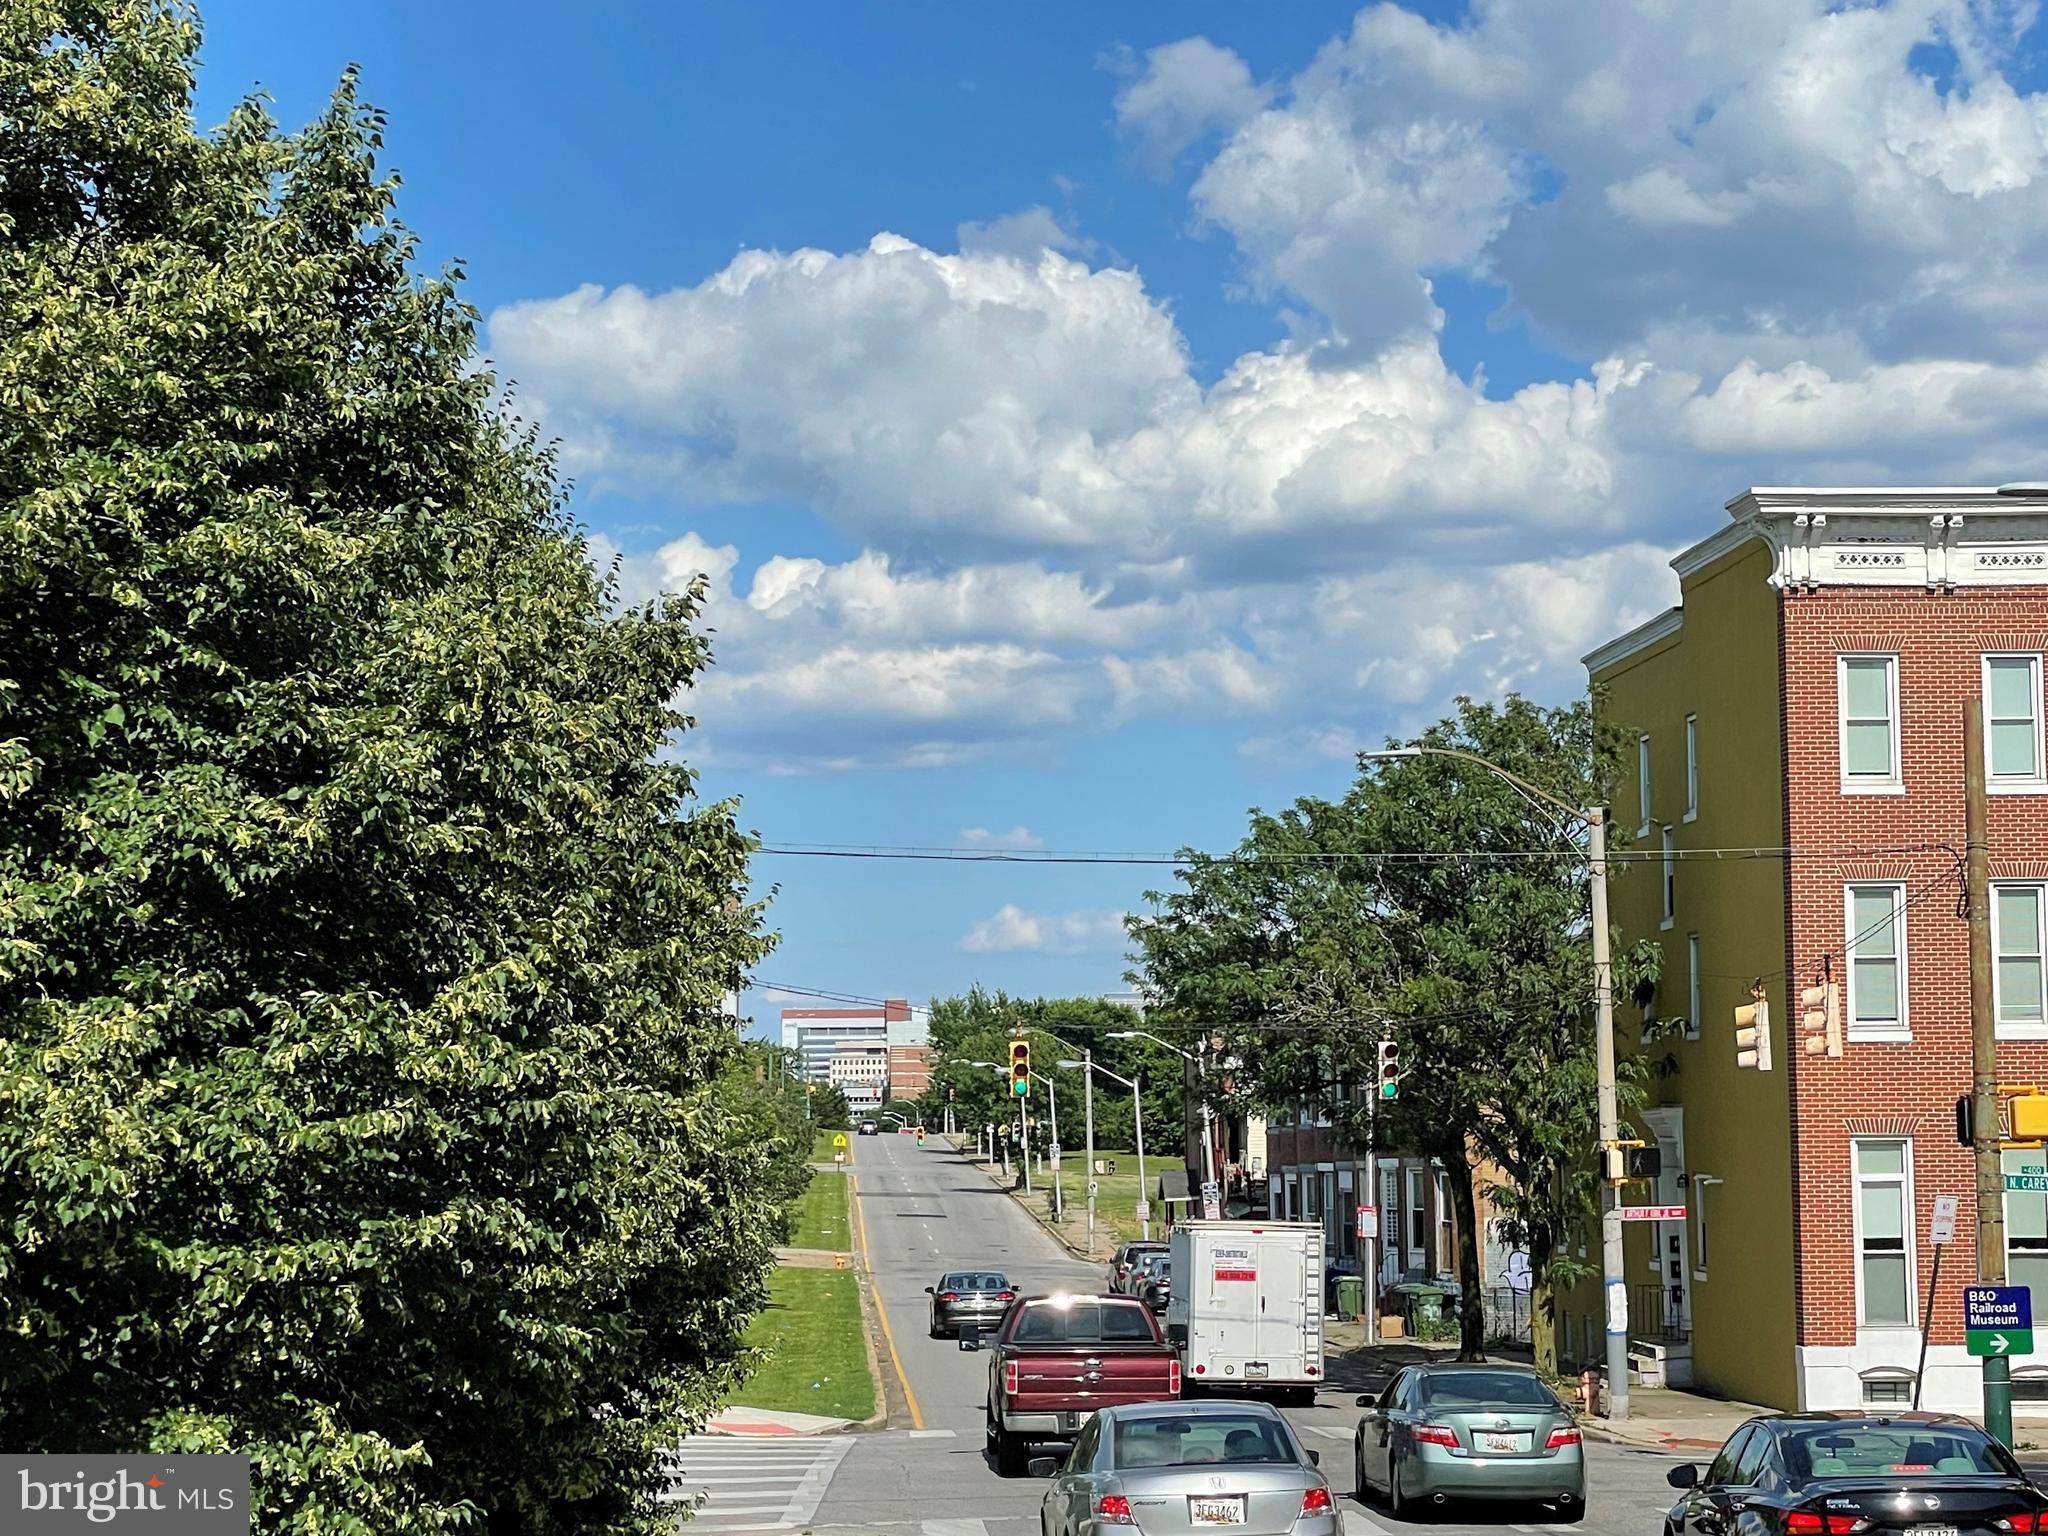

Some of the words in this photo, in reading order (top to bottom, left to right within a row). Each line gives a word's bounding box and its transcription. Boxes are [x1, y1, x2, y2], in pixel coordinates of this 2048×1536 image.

[2010, 1176, 2019, 1189] N.
[1969, 1291, 1996, 1301] B&O
[1969, 1302, 2017, 1313] Railroad
[1970, 1314, 2019, 1325] Museum
